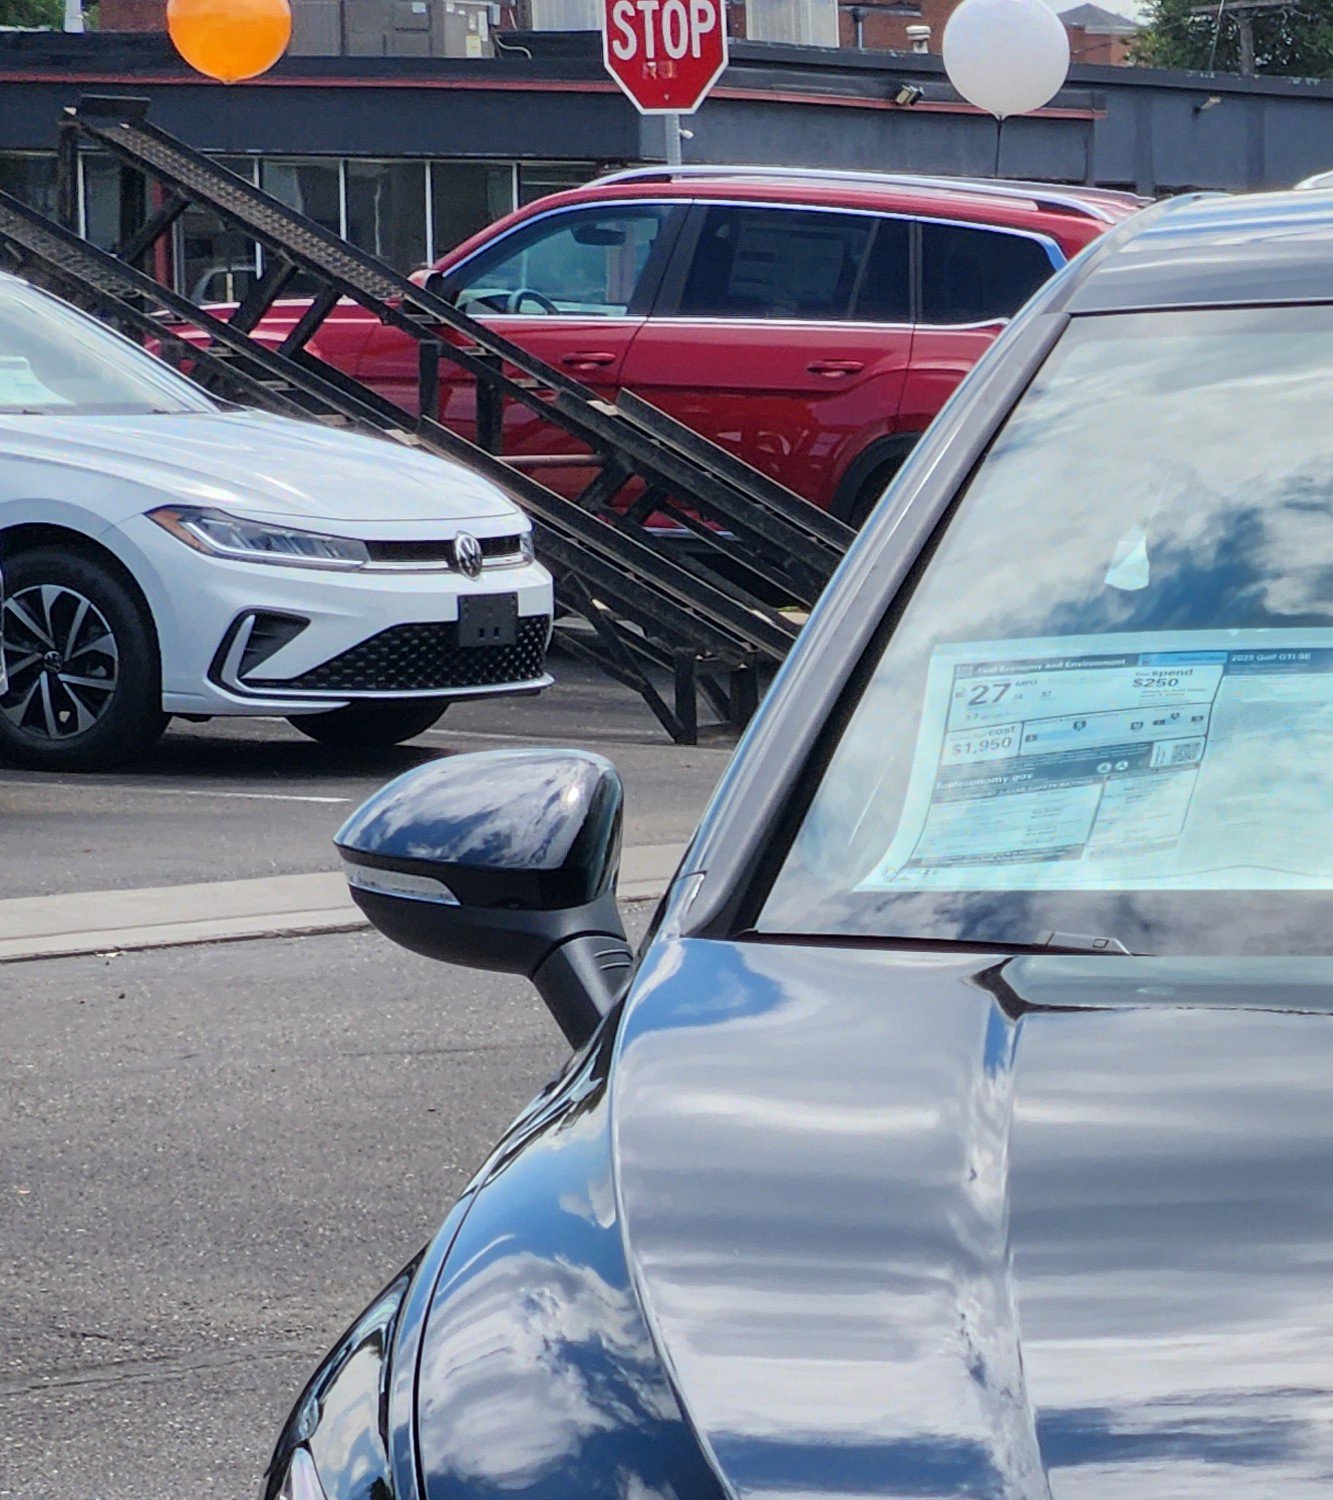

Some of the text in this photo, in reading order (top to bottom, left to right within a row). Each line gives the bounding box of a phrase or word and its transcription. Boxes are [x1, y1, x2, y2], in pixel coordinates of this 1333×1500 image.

[612, 0, 717, 60] STOP
[1279, 652, 1296, 661] GTI
[1065, 658, 1126, 668] Environment
[1152, 668, 1194, 677] spend
[1132, 677, 1180, 689] $250
[967, 682, 1012, 706] 27
[988, 725, 1016, 736] cost
[950, 736, 1013, 756] $1,950
